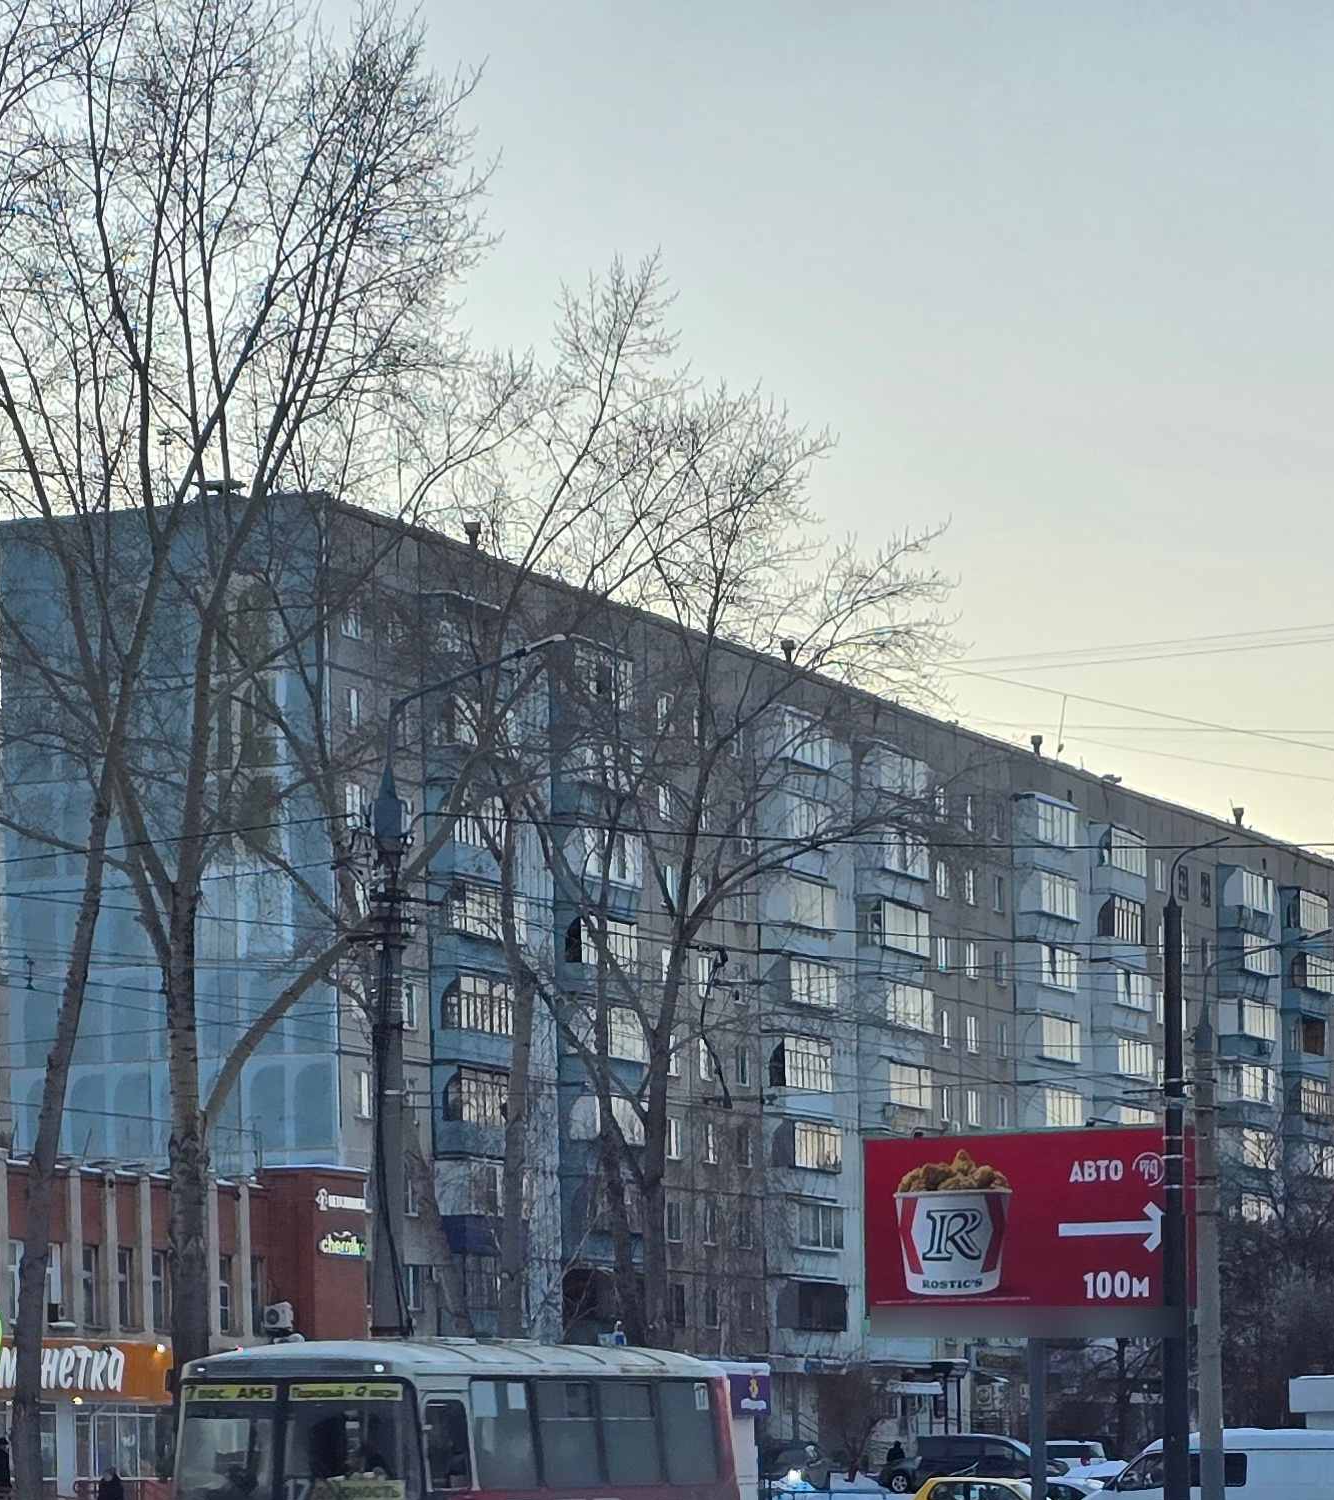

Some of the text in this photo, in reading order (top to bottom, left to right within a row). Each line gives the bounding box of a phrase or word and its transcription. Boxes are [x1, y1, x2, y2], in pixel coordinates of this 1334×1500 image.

[1069, 1159, 1124, 1183] АВТО
[922, 1208, 982, 1261] R
[922, 1278, 983, 1289] ROSTIC'S
